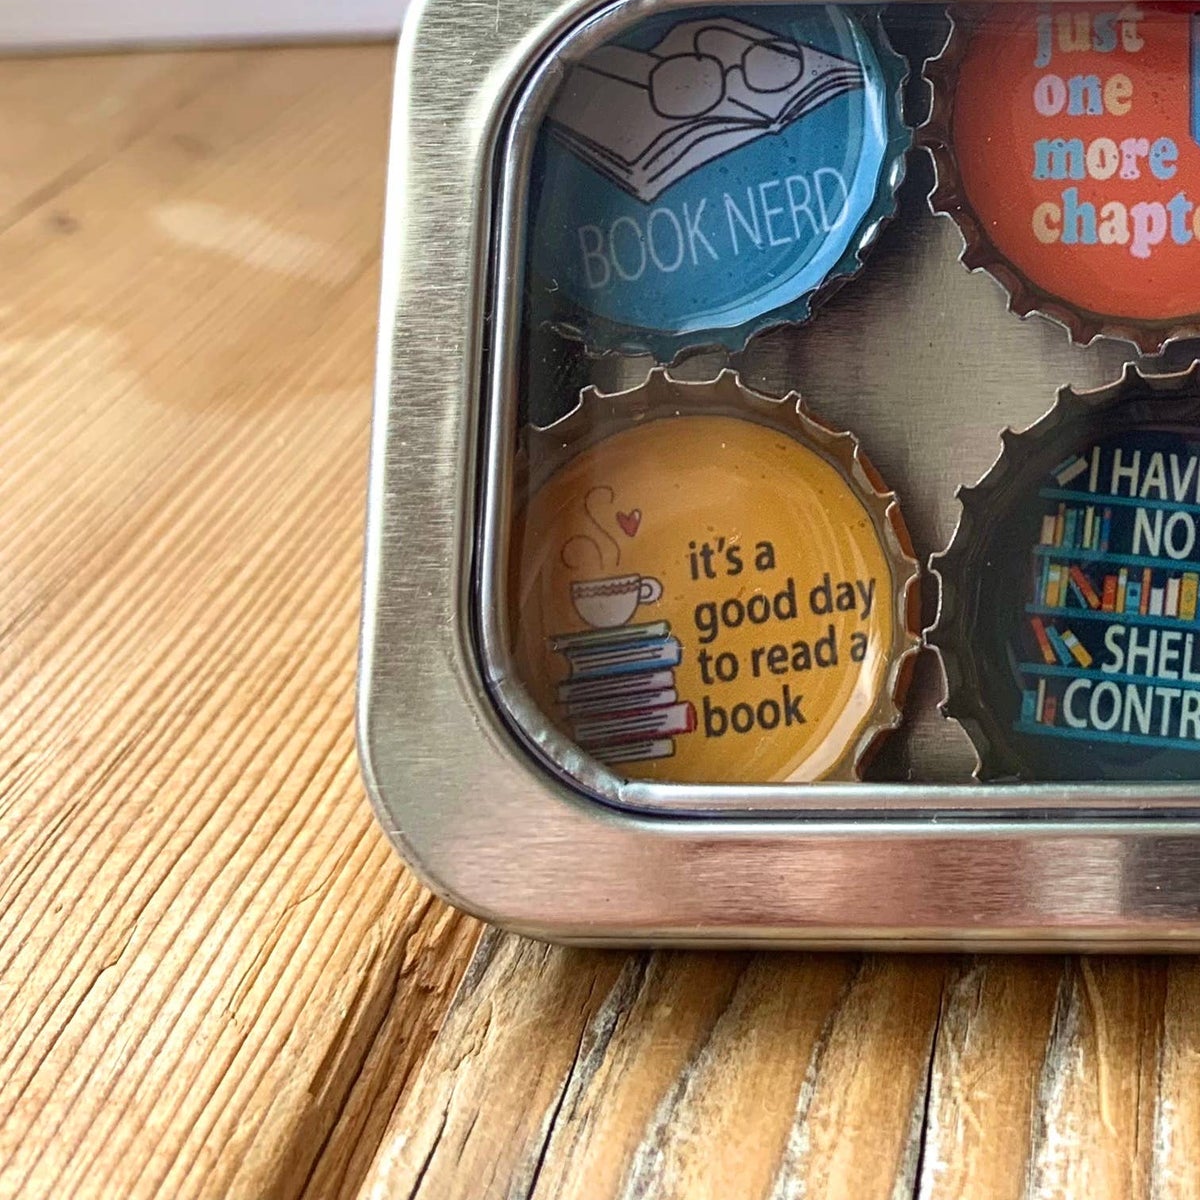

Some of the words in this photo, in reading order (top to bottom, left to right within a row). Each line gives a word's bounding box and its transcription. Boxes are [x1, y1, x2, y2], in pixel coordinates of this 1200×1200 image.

[1033, 2, 1145, 68] just
[1033, 73, 1133, 117] one
[1032, 136, 1179, 181] more
[577, 193, 717, 290] BOOK
[723, 166, 849, 256] NERD
[1088, 445, 1101, 493] I
[686, 539, 744, 581] it's
[754, 539, 777, 574] a
[1131, 507, 1197, 560] NO
[693, 577, 798, 645] good
[808, 571, 876, 621] day
[697, 645, 740, 685] to
[750, 624, 837, 678] read
[850, 631, 869, 663] a
[703, 684, 808, 739] book
